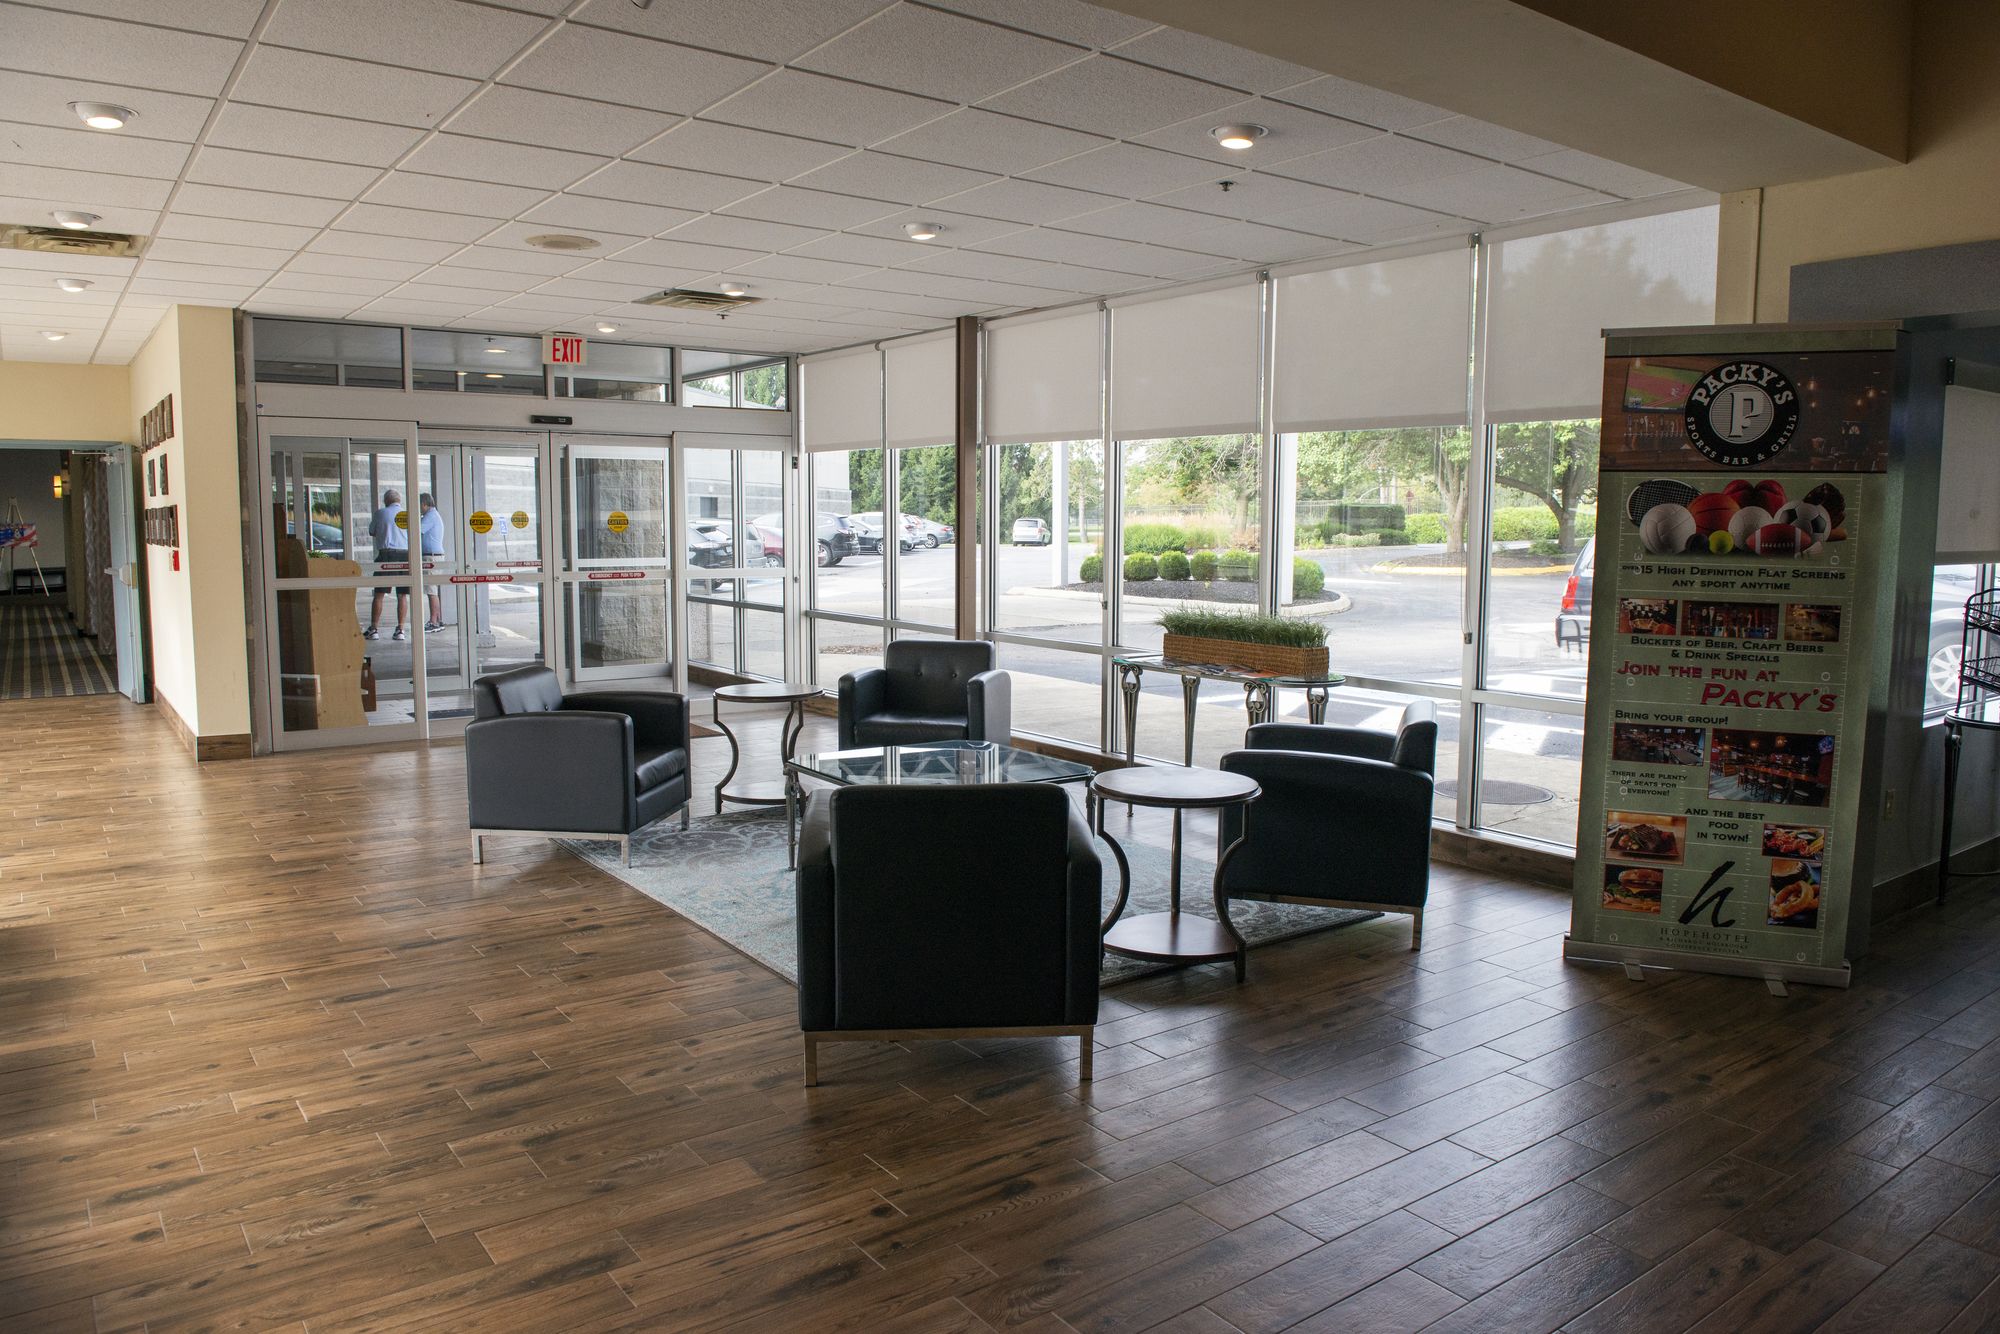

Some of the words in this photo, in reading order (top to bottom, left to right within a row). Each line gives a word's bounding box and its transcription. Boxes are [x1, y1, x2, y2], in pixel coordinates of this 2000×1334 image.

[552, 338, 582, 363] EXIT
[1692, 364, 1794, 406] PACKY'S
[1687, 417, 1717, 458] SPORTS
[1722, 456, 1749, 465] BAR
[1757, 453, 1765, 461] &
[1771, 414, 1797, 452] GRILL
[1641, 565, 1653, 574] 15
[1658, 565, 1686, 575] HIGH
[1691, 567, 1753, 577] DEFINITION
[1759, 568, 1787, 578] FLAT
[1792, 570, 1846, 580] SCREENS
[1740, 582, 1791, 590] ANYTIME
[1631, 636, 1681, 646] BUCKETS
[1686, 639, 1700, 647] OF
[1742, 641, 1781, 651] CRAFT
[1786, 643, 1824, 653] BEERS
[1671, 649, 1679, 658] &
[1685, 650, 1720, 660] DRINK
[1726, 652, 1779, 662] SPECIALS
[1617, 661, 1660, 676] JOIN
[1668, 665, 1703, 678] THE
[1711, 667, 1748, 680] FUN
[1756, 670, 1779, 682] AT
[1701, 682, 1838, 712] PACKY'S
[1615, 710, 1649, 720] BRING
[1654, 714, 1683, 722] YOUR
[1688, 716, 1728, 725] GROUP!
[1627, 788, 1669, 796] EVERYONE!
[1685, 808, 1708, 816] AND
[1713, 810, 1733, 818] THE
[1738, 812, 1765, 820] BEST
[1708, 821, 1739, 829] FOOD
[1712, 833, 1749, 842] TOWN!
